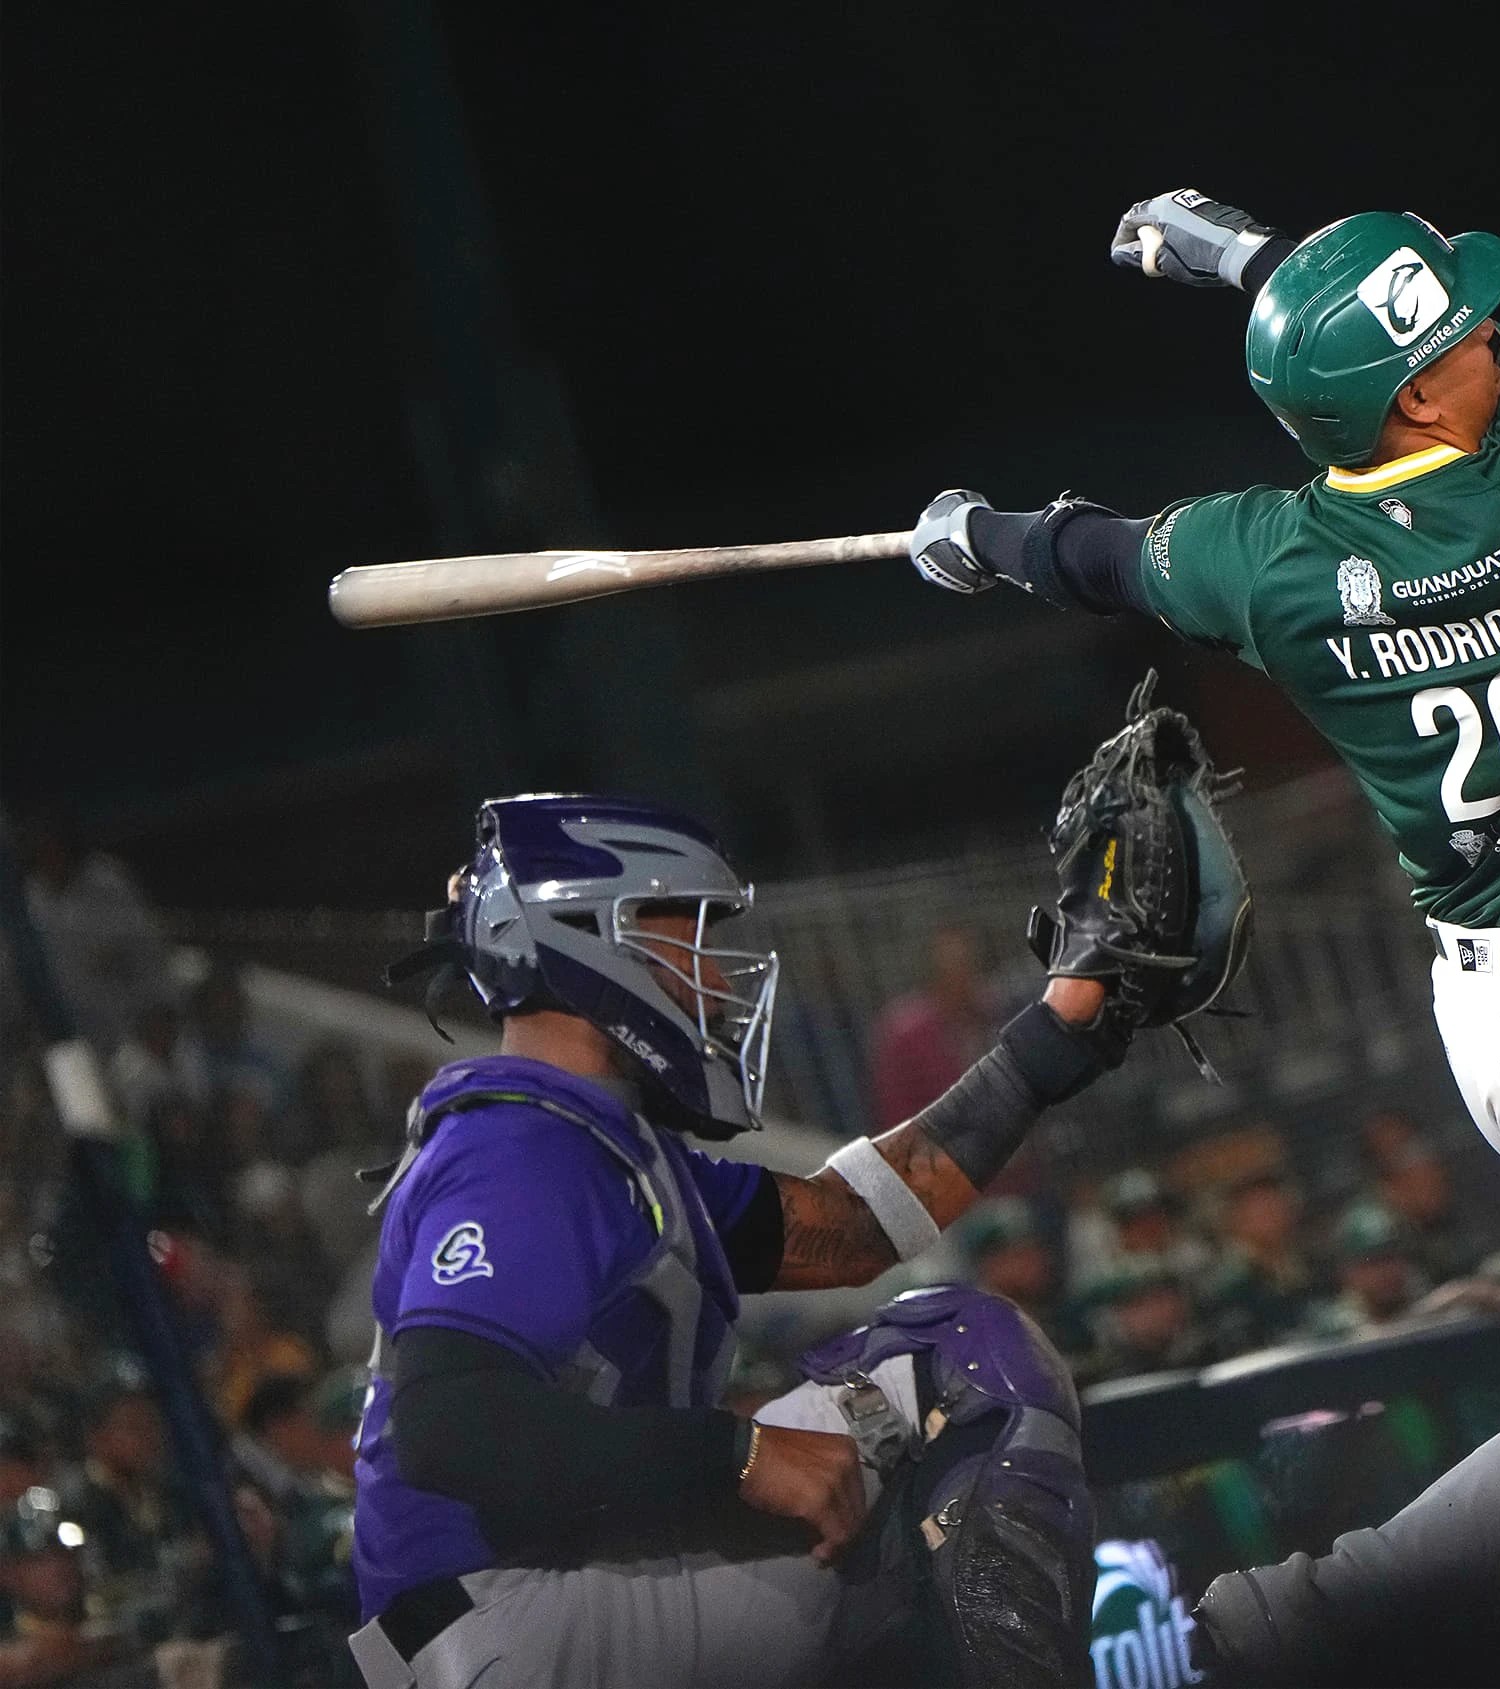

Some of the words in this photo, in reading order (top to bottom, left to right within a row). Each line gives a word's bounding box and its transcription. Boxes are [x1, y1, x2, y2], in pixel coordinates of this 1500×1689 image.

[1412, 588, 1466, 606] GOBIERNO
[1470, 578, 1490, 591] DEL
[1327, 637, 1370, 679] Y.
